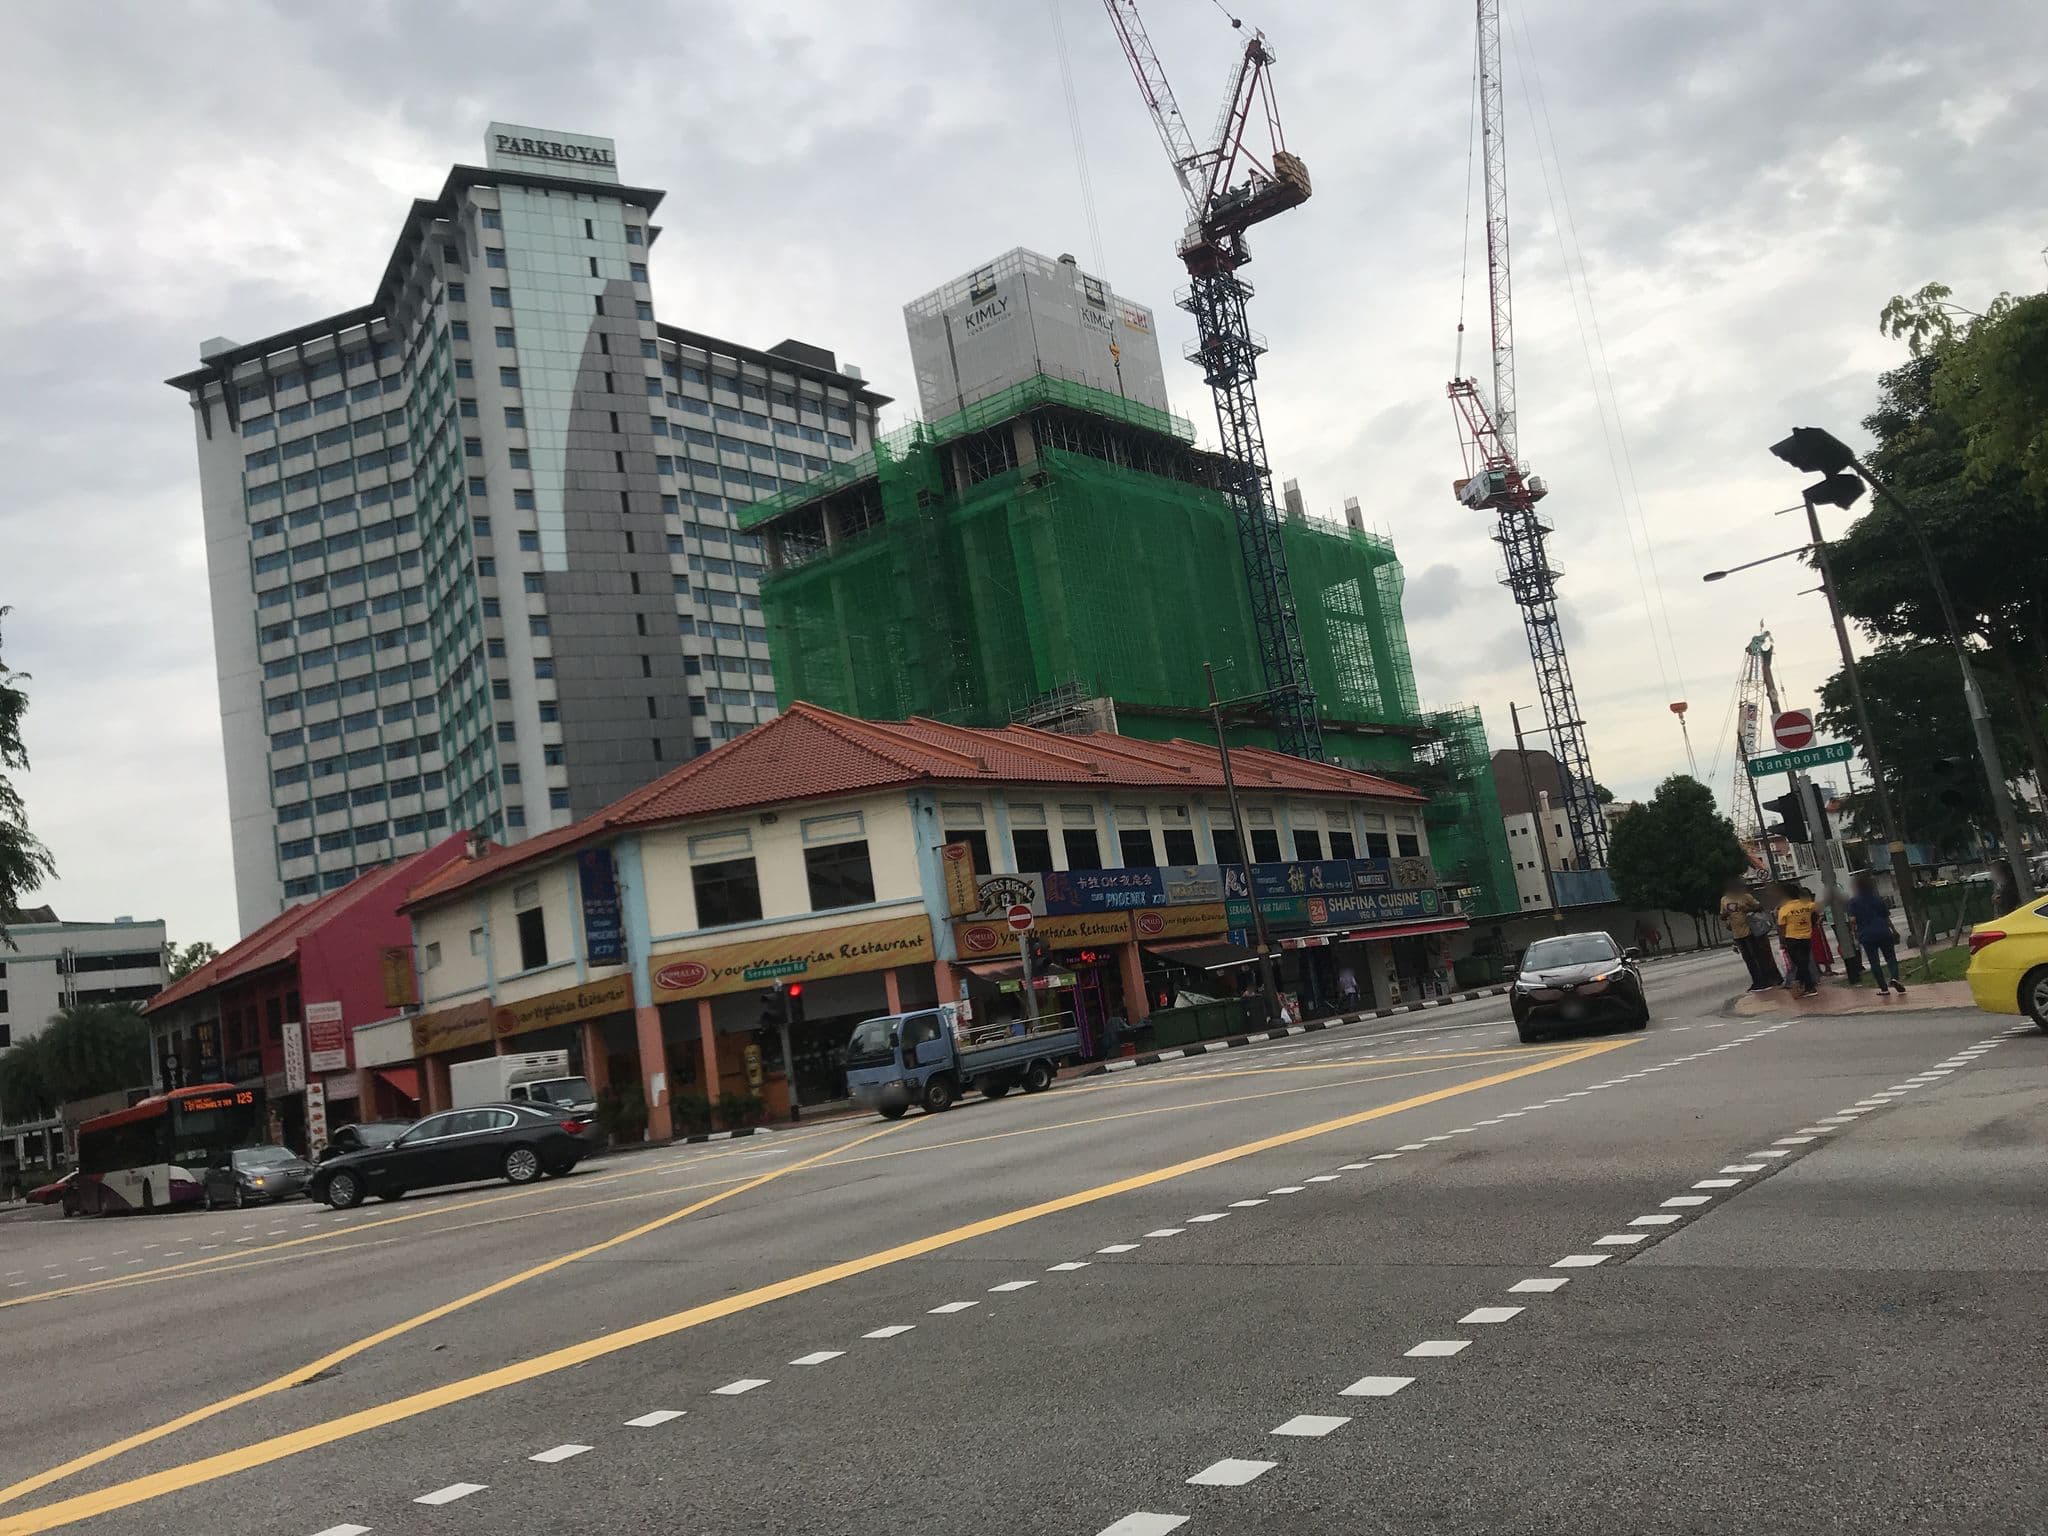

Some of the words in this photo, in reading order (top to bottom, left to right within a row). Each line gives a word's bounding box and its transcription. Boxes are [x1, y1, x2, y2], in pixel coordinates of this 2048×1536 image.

[495, 134, 615, 163] PARKROYAL
[965, 296, 1008, 329] KIMLY
[1081, 307, 1114, 331] KIMLY
[1756, 752, 1820, 772] Rangoon
[1826, 745, 1845, 759] Rd
[1105, 891, 1146, 908] PHOENIX
[1329, 894, 1377, 912] SHAFINA
[1379, 892, 1419, 909] CUISINE
[1311, 905, 1325, 916] 24
[1080, 922, 1128, 937] Restaurant
[839, 934, 925, 959] Restaurant
[659, 967, 701, 983] KOMALAS
[746, 964, 792, 979] Serangoon
[793, 962, 805, 972] Rd
[236, 1092, 252, 1104] 125
